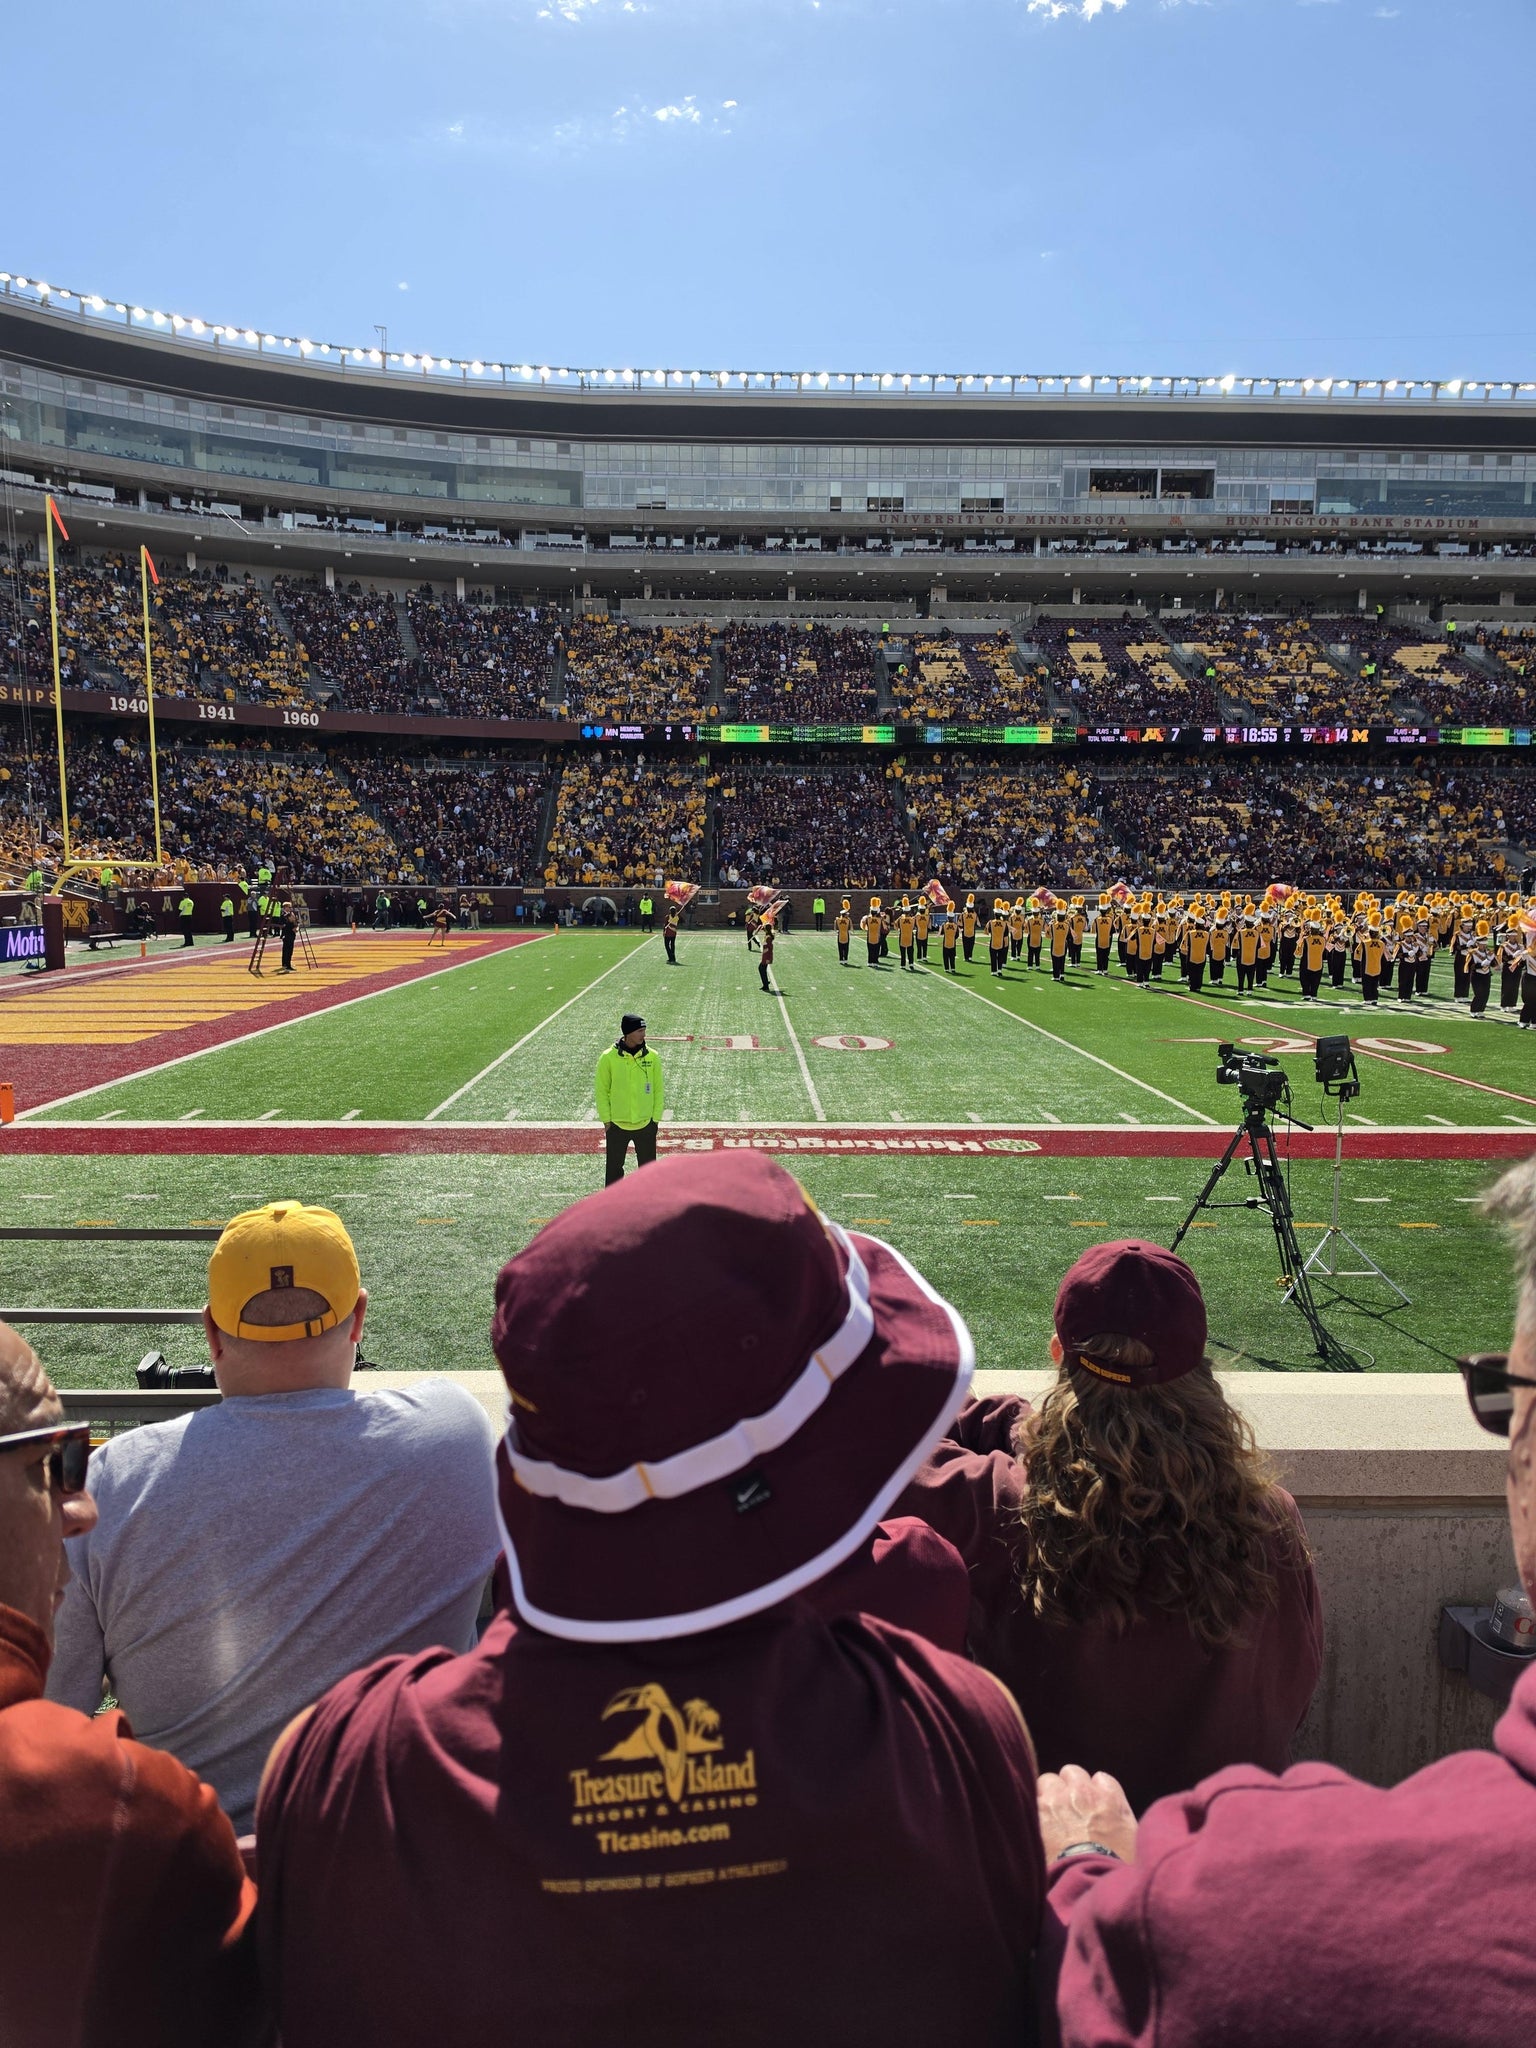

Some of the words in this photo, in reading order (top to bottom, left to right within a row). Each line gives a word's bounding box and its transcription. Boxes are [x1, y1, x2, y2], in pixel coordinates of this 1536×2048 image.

[878, 514, 986, 525] UNIVERSITY
[996, 514, 1016, 525] OF
[1025, 515, 1127, 526] MINNESOTA
[1225, 516, 1341, 527] HUNTINGTON
[1350, 517, 1395, 527] BANK
[1403, 518, 1480, 528] STADIUM
[110, 696, 148, 713] 1940
[198, 704, 235, 721] 1941
[283, 711, 320, 726] 1960
[605, 728, 618, 737] MN
[1171, 728, 1180, 742] 7
[1203, 734, 1216, 742] 4TH
[1284, 734, 1290, 742] 2
[1303, 734, 1313, 742] 27
[1335, 728, 1348, 742] 14
[723, 1138, 985, 1153] Huntington
[569, 1767, 664, 1807] Treasure
[685, 1748, 757, 1796] Island
[571, 1805, 647, 1827] RESORT
[655, 1803, 669, 1816] &
[679, 1793, 758, 1814] CASINO
[584, 1876, 642, 1892] SPONSOR
[645, 1874, 662, 1889] OF
